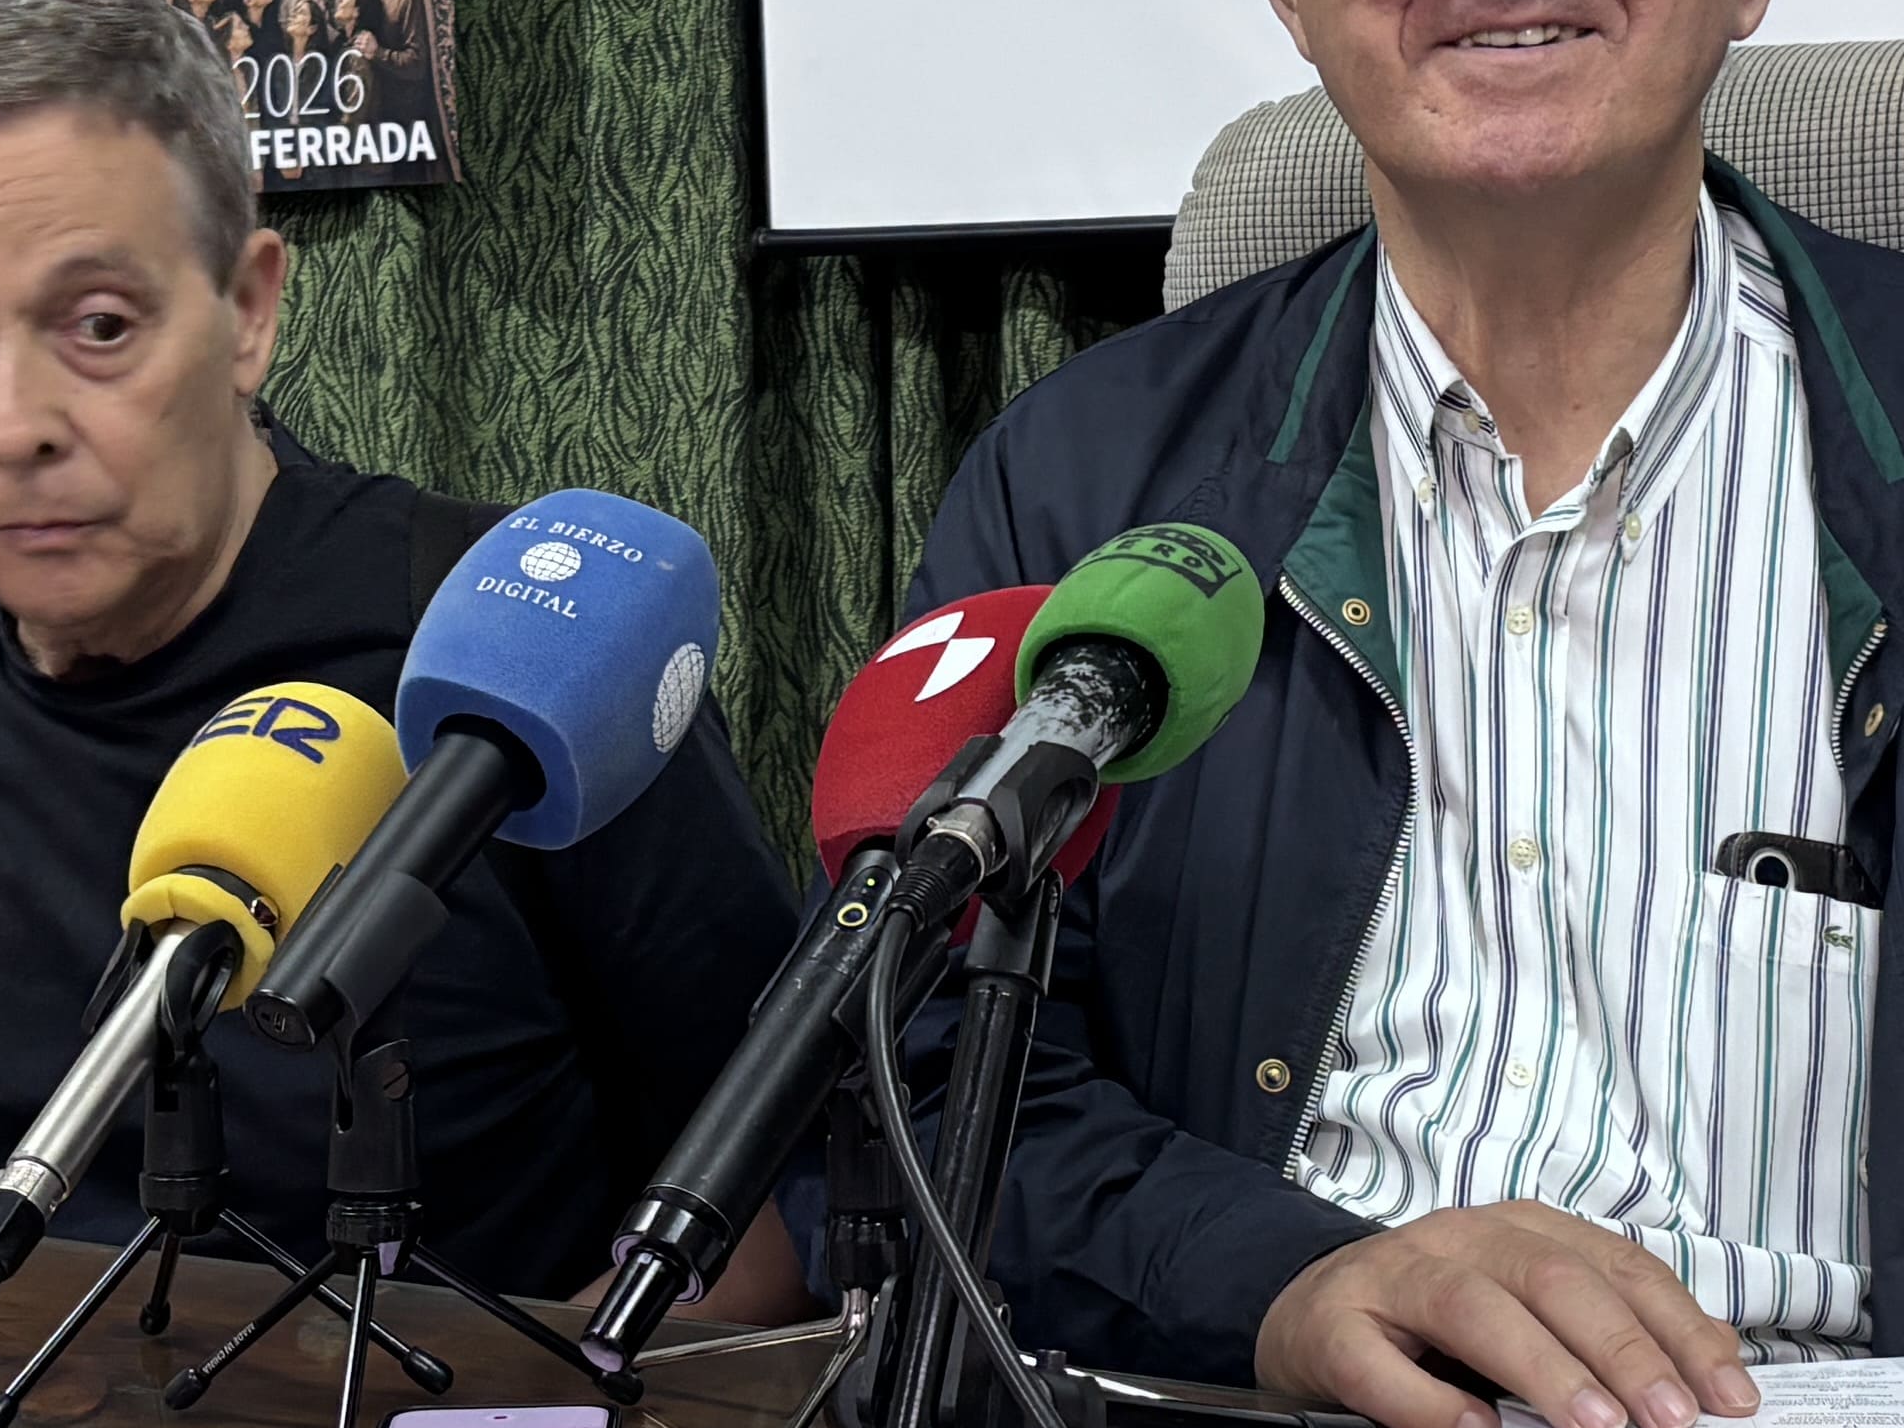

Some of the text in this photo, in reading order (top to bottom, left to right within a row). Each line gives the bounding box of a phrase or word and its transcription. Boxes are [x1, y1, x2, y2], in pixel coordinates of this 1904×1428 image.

[232, 48, 366, 119] 2026
[249, 120, 438, 170] FERRADA
[509, 514, 644, 564] EL BIERZO
[475, 574, 580, 620] DIGITAL
[191, 695, 341, 765] ER
